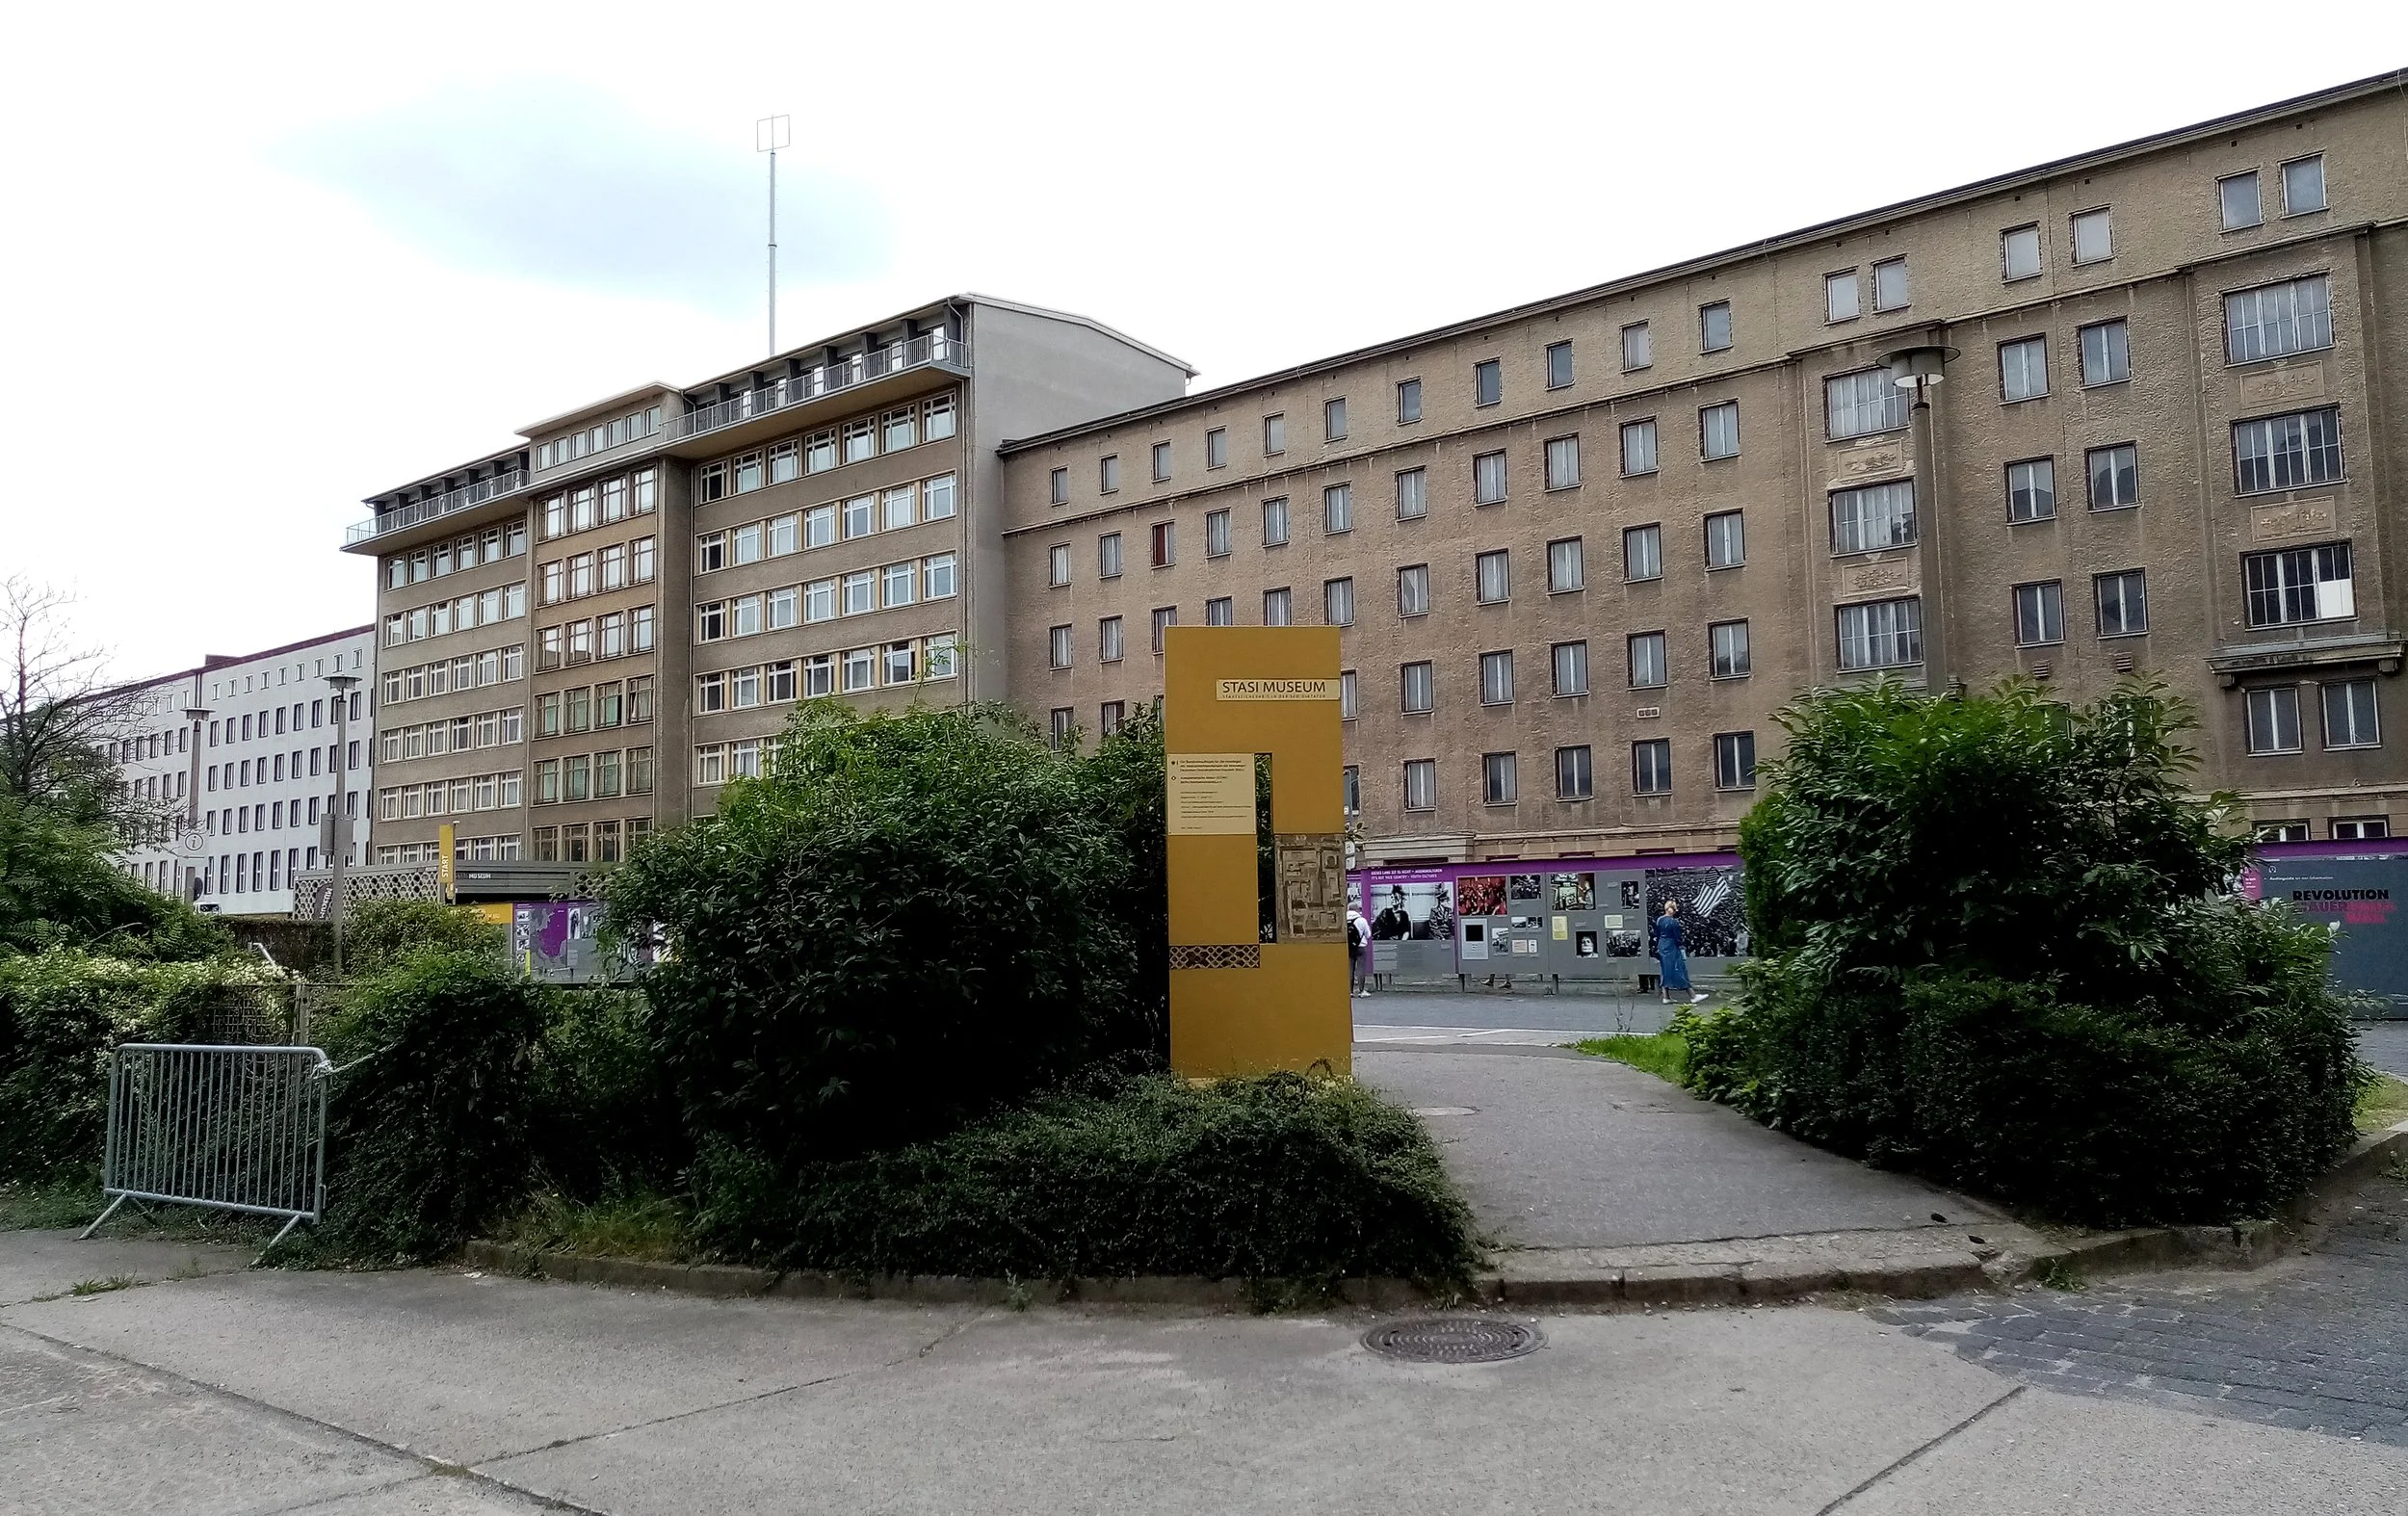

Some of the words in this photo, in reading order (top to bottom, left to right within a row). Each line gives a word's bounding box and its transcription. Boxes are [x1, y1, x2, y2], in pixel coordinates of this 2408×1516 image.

[1222, 681, 1259, 693] STASI
[1263, 681, 1326, 693] MUSEUM
[2292, 889, 2389, 901] REVOLUTION
